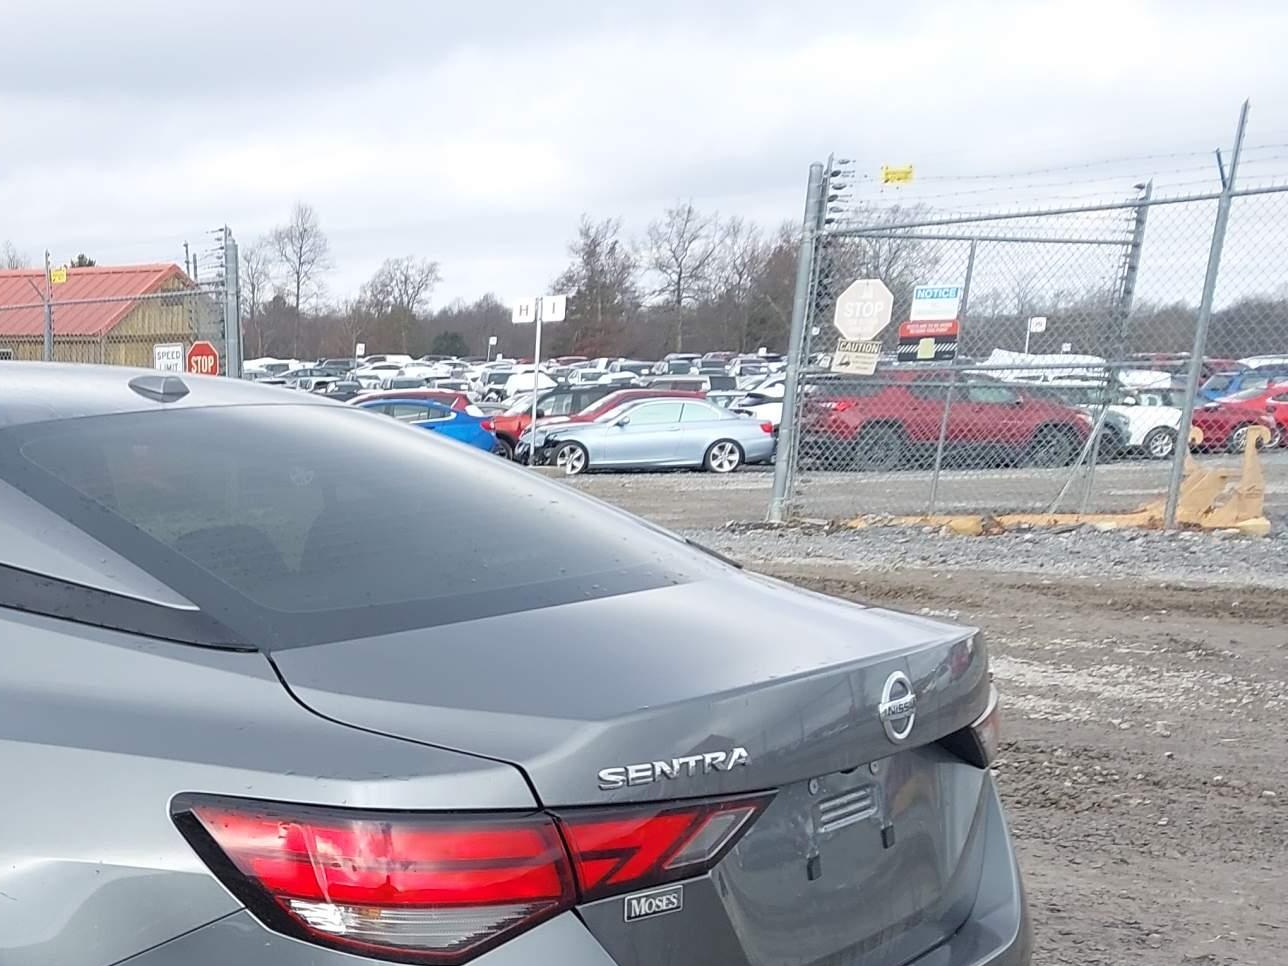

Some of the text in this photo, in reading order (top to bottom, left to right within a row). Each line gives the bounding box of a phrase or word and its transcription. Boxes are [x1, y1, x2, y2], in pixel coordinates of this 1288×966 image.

[917, 288, 956, 298] NOTICE
[844, 301, 884, 318] STOP
[840, 342, 879, 353] CAUTION
[157, 350, 181, 360] SPEED
[191, 355, 215, 374] STOP
[598, 747, 751, 791] SENTRA
